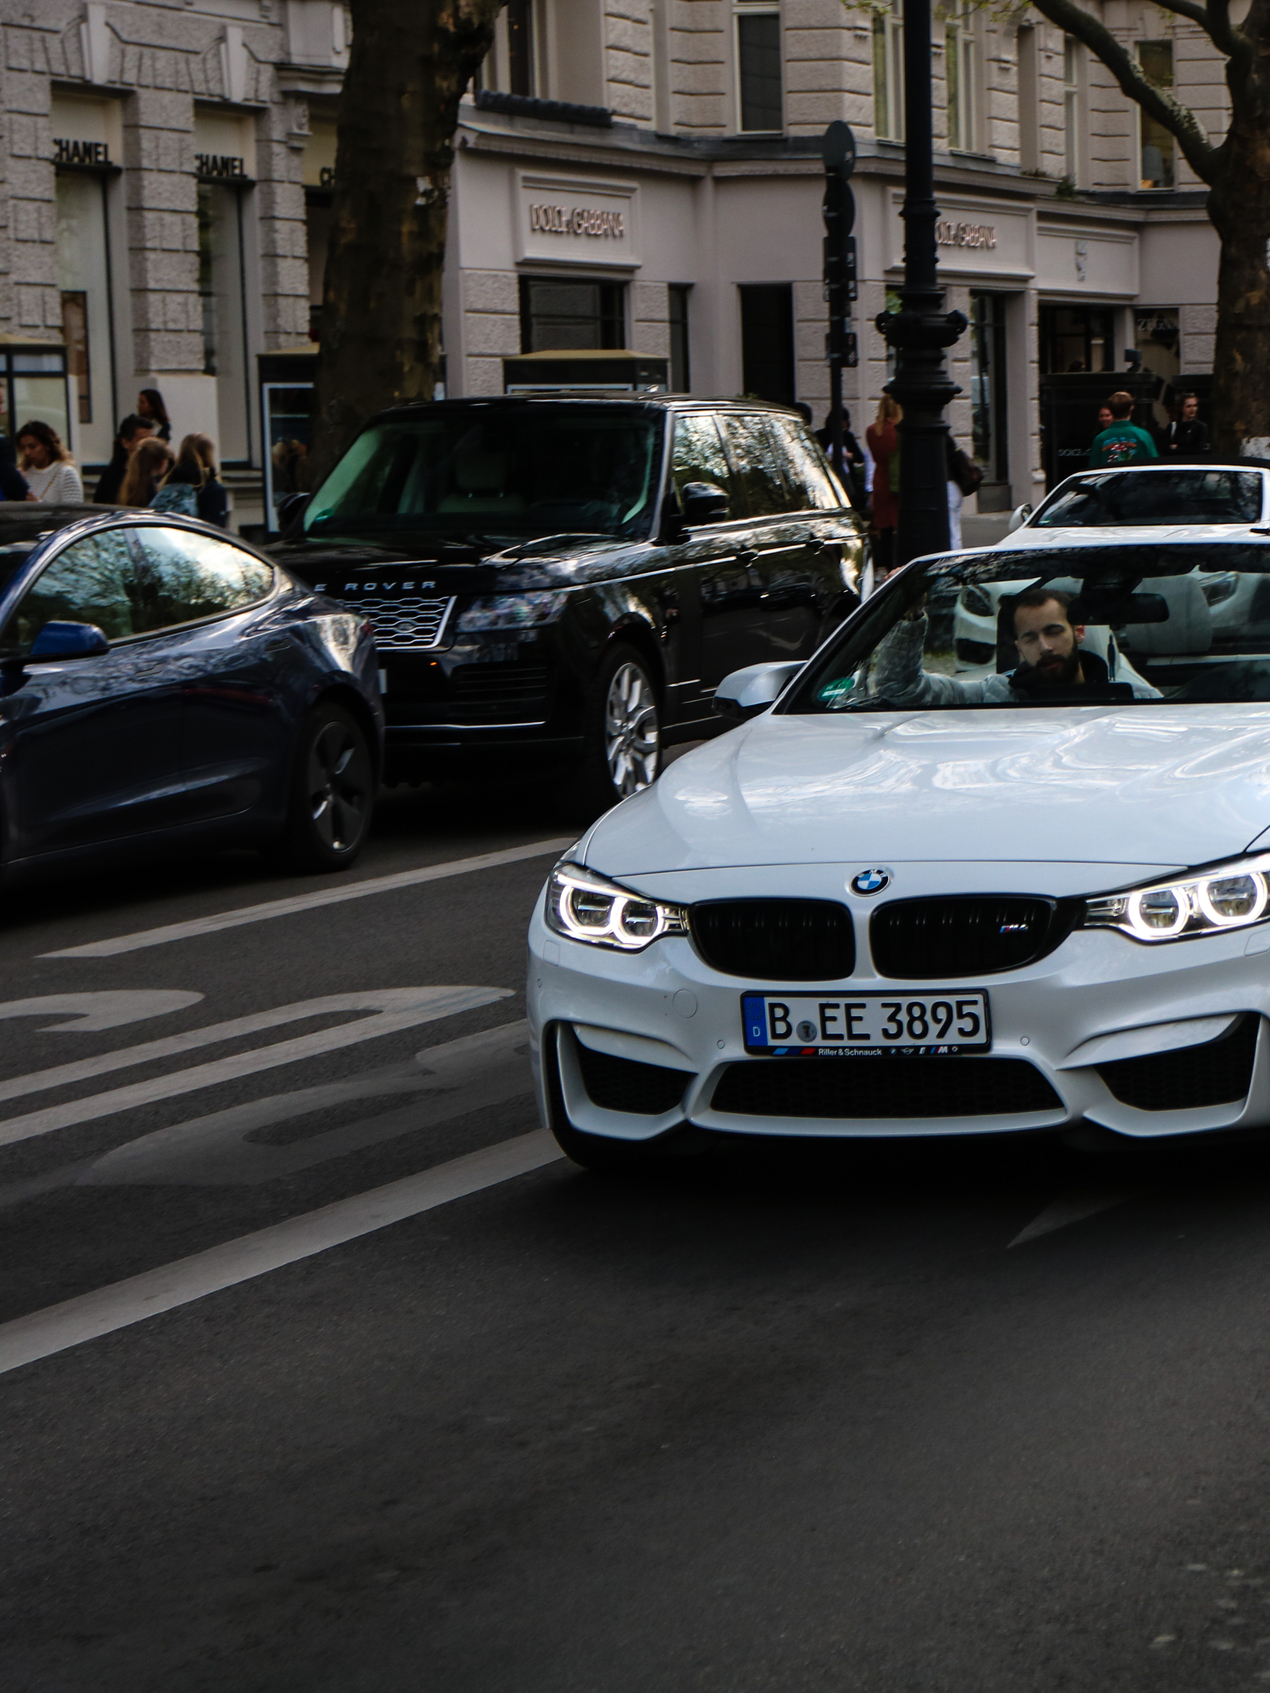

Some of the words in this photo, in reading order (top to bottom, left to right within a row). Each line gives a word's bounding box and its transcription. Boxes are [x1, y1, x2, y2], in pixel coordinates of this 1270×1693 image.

[344, 580, 437, 591] ROVER
[768, 1002, 793, 1040] B
[819, 1002, 871, 1041] EE
[881, 999, 980, 1040] 3895
[752, 1026, 761, 1037] D
